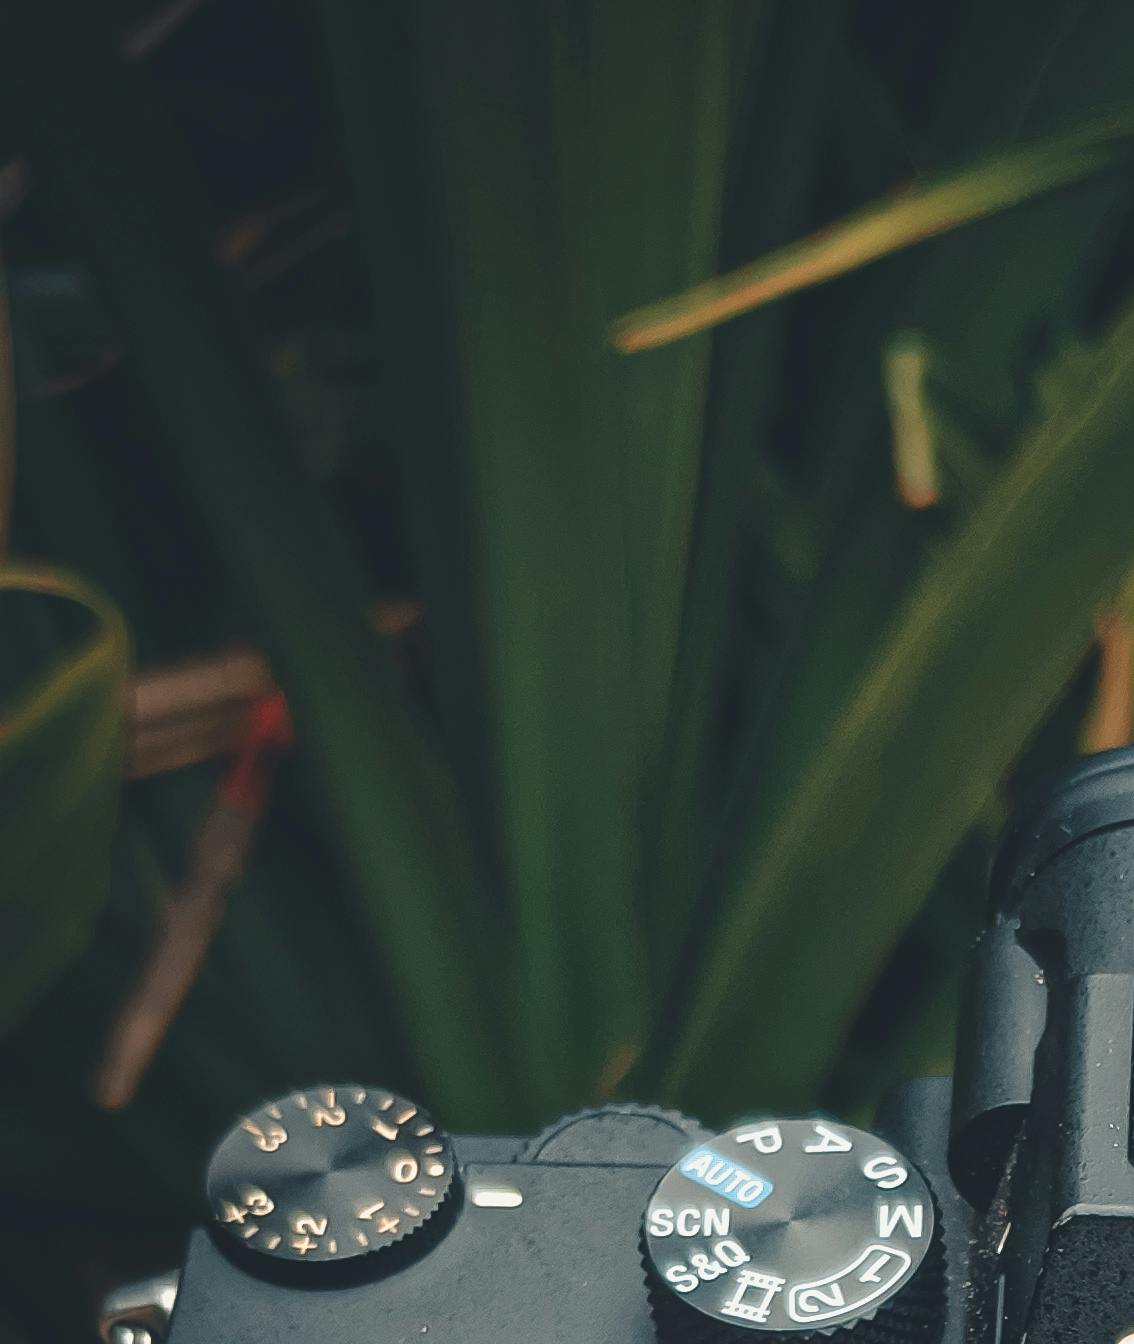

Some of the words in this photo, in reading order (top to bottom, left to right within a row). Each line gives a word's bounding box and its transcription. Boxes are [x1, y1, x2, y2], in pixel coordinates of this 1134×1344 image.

[736, 1127, 783, 1154] P
[804, 1125, 852, 1153] A
[684, 1153, 765, 1202] AUTO
[863, 1156, 908, 1190] S
[649, 1208, 730, 1237] SCN
[878, 1204, 924, 1239] M
[665, 1240, 751, 1294] S&Q
[859, 1254, 891, 1284] 1
[799, 1282, 846, 1313] 2
